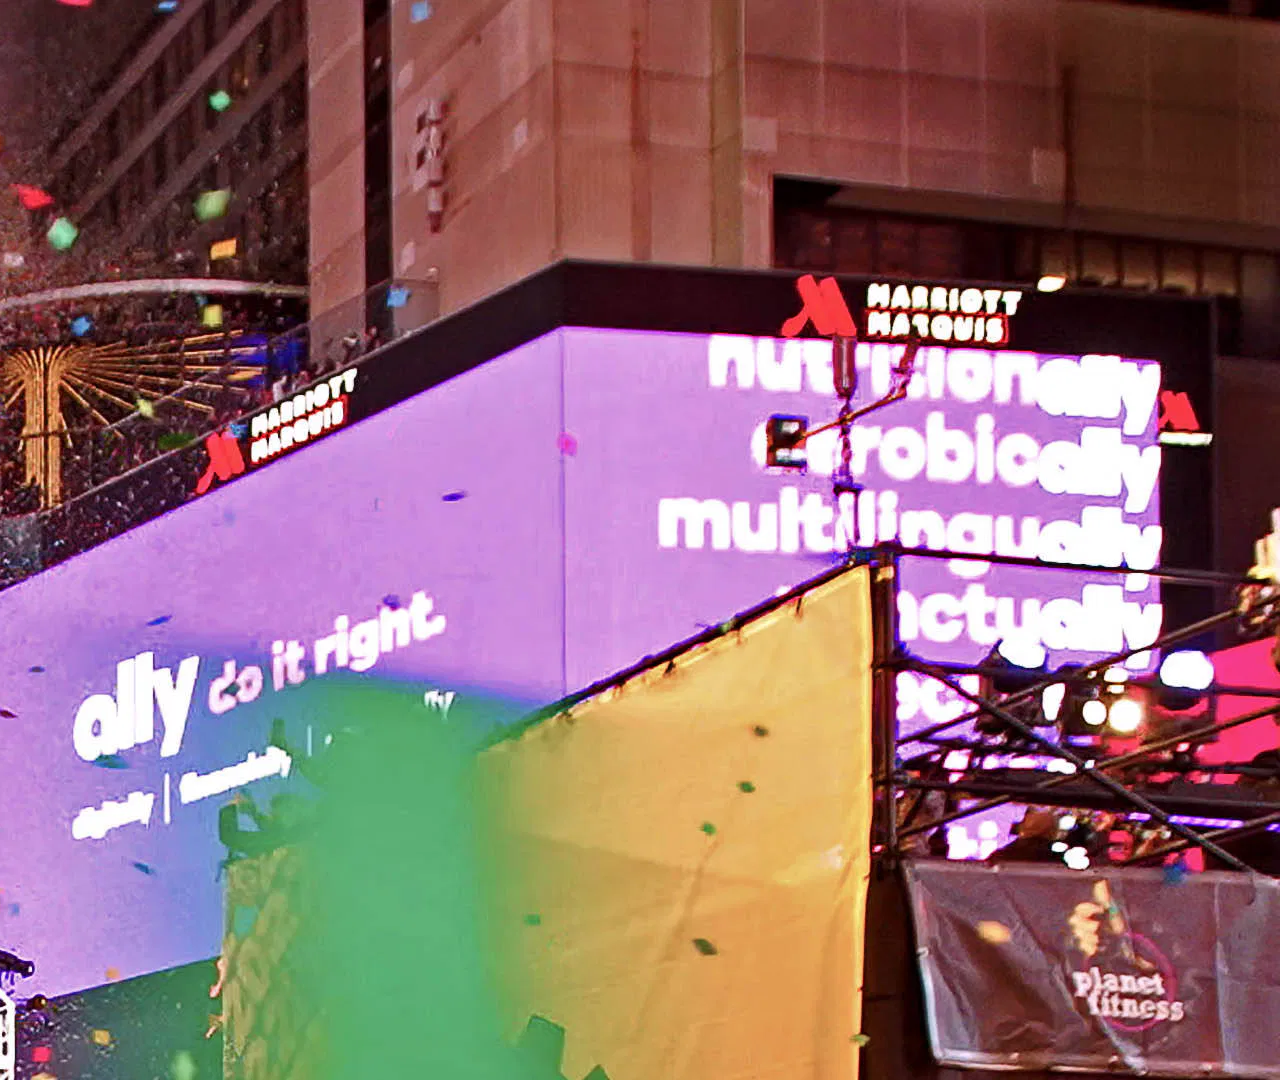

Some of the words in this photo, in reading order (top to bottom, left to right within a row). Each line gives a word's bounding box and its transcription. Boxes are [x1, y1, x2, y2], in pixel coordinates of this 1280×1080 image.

[867, 283, 1022, 315] MARRIOTT
[251, 367, 358, 438] MARRIOTT
[208, 660, 263, 714] do
[271, 639, 306, 691] it
[72, 651, 200, 762] ally
[1072, 966, 1165, 998] planet
[1087, 984, 1185, 1021] fitness
